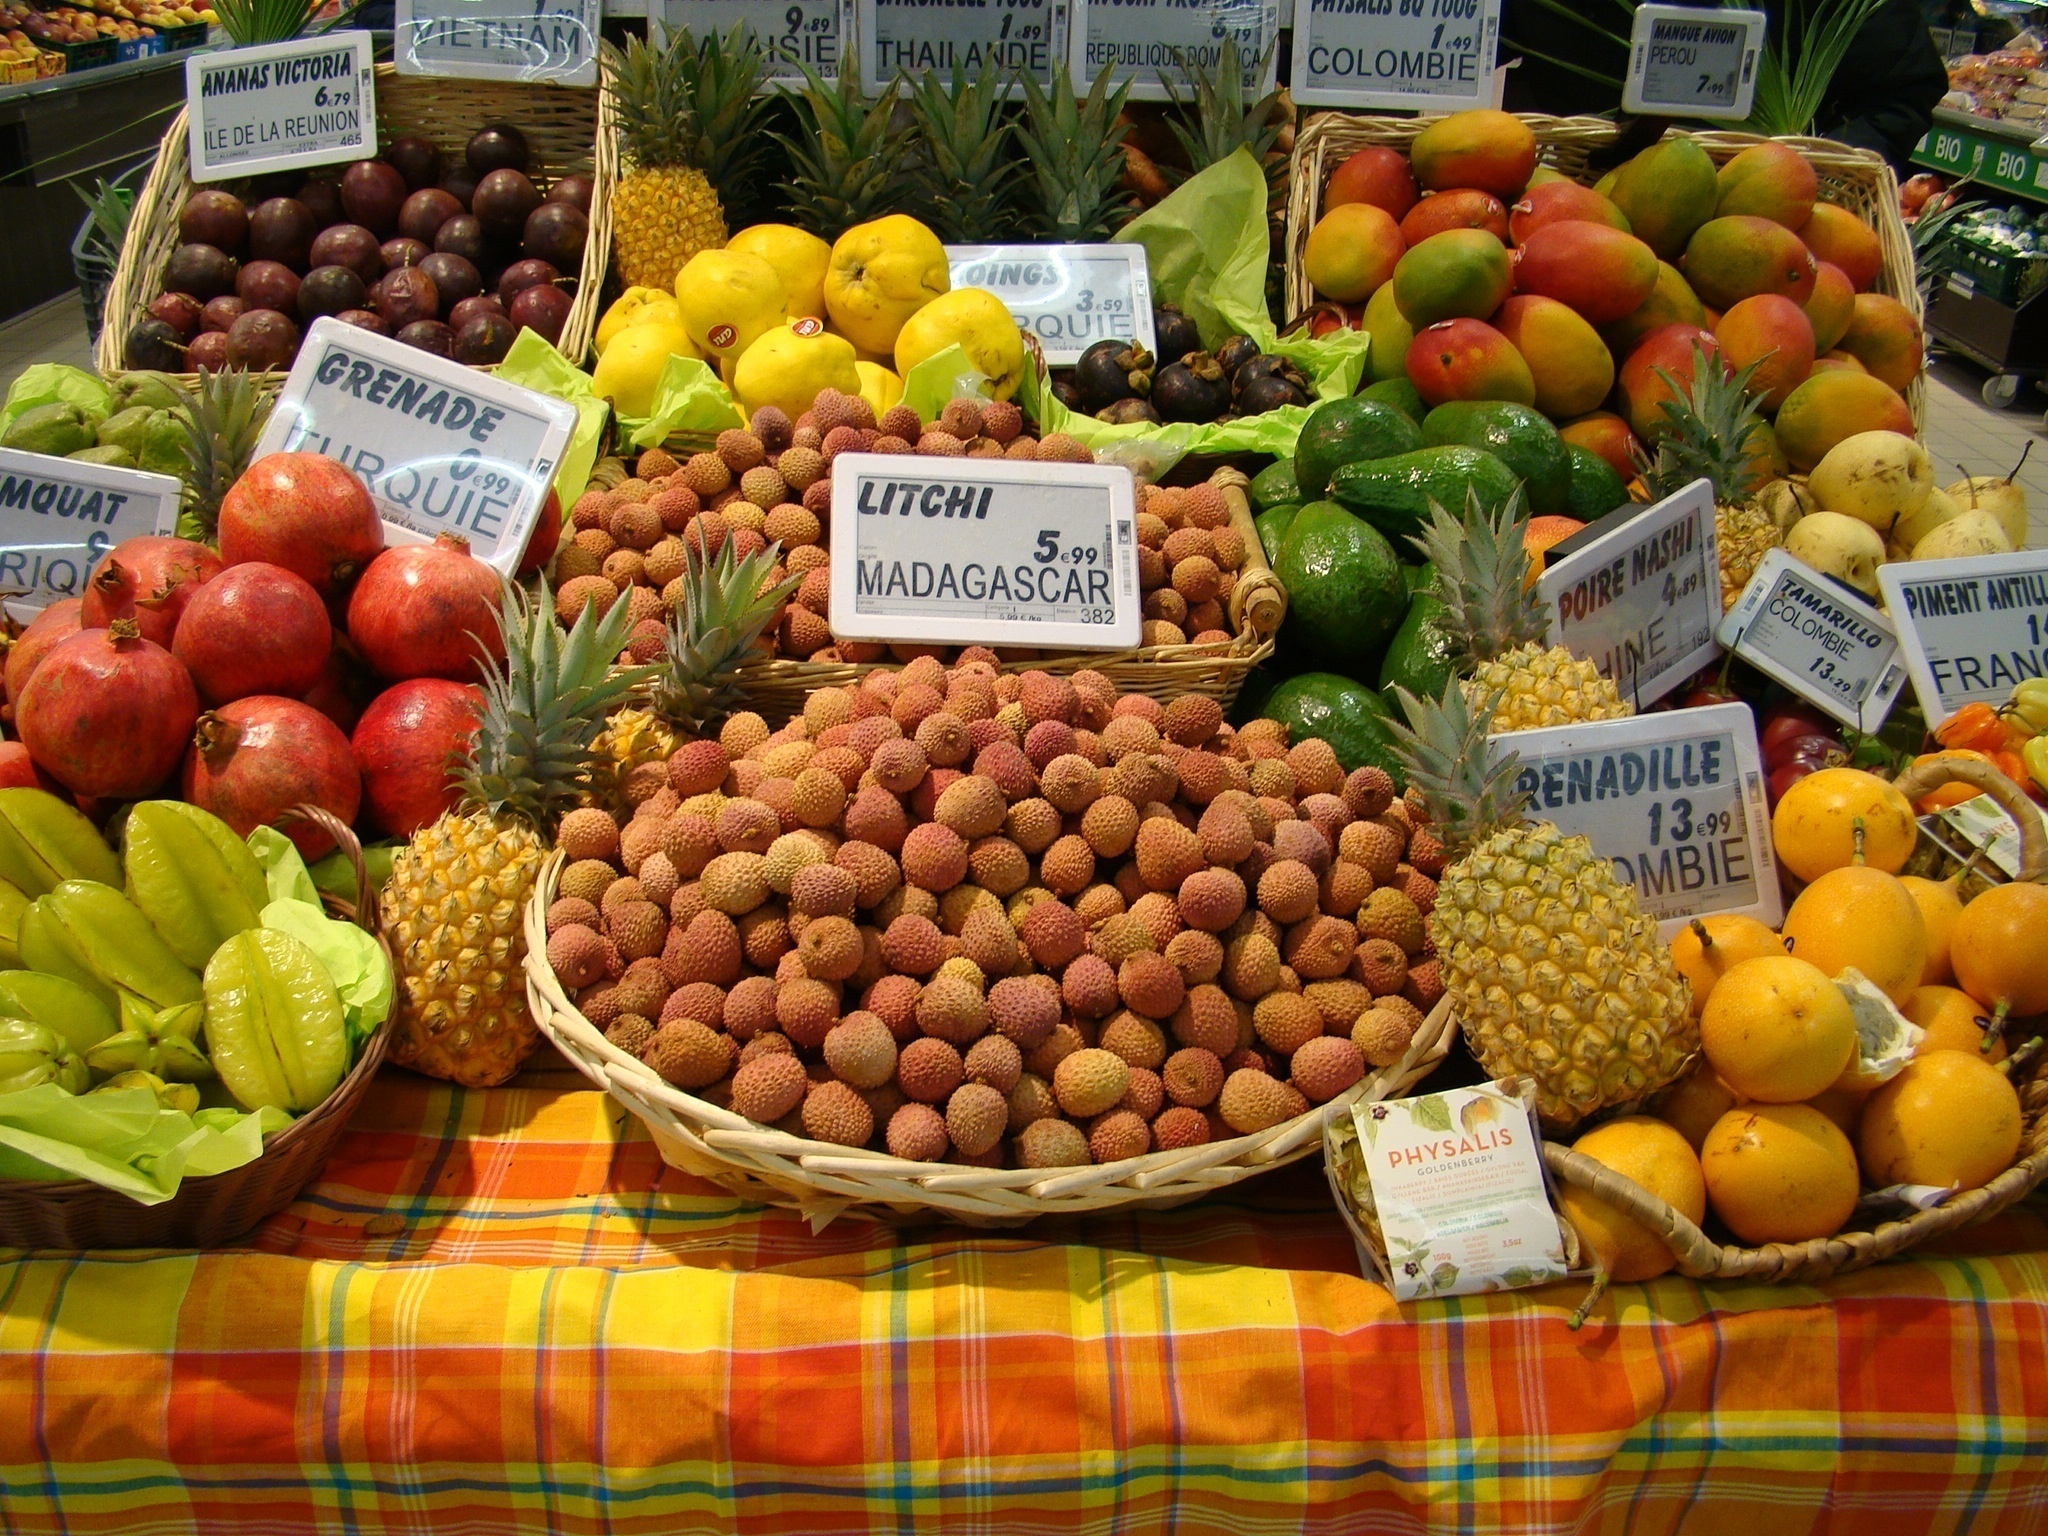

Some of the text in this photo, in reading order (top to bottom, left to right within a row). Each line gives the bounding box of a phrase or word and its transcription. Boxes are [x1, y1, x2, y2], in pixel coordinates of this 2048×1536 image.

[412, 17, 580, 54] VIETNAM
[999, 13, 1041, 40] 1€89
[1430, 23, 1472, 51] 1€49
[1653, 24, 1737, 45] MANGUE AVION
[202, 52, 351, 97] ANANAS VICTORIA
[1308, 46, 1477, 82] COLOMBIE
[1650, 46, 1697, 66] PEROU
[314, 86, 351, 107] 6€79
[204, 109, 359, 150] ILE DE LA REUNION
[339, 134, 362, 147] 465
[1934, 134, 1961, 163] BIO
[1995, 151, 2026, 182] BIO
[953, 262, 1058, 286] OINGS
[317, 352, 506, 443] GRENADE
[0, 475, 128, 525] MQUAT
[857, 481, 993, 519] LITCHI
[1033, 529, 1098, 566] 5€99
[857, 559, 1112, 605] MADAGASCAR
[1558, 516, 1693, 632] POIRE NASHI
[1080, 608, 1115, 625] 382
[1780, 579, 1882, 649] TAMARILLO
[1902, 581, 1981, 619] PIMENT
[1769, 598, 1856, 661] COLOMBIE
[1511, 740, 1721, 812] RENADILLE
[1647, 797, 1731, 846] 13€99
[1387, 1128, 1513, 1169] PHYSALIS
[1417, 1154, 1494, 1176] GOLDENBERRY
